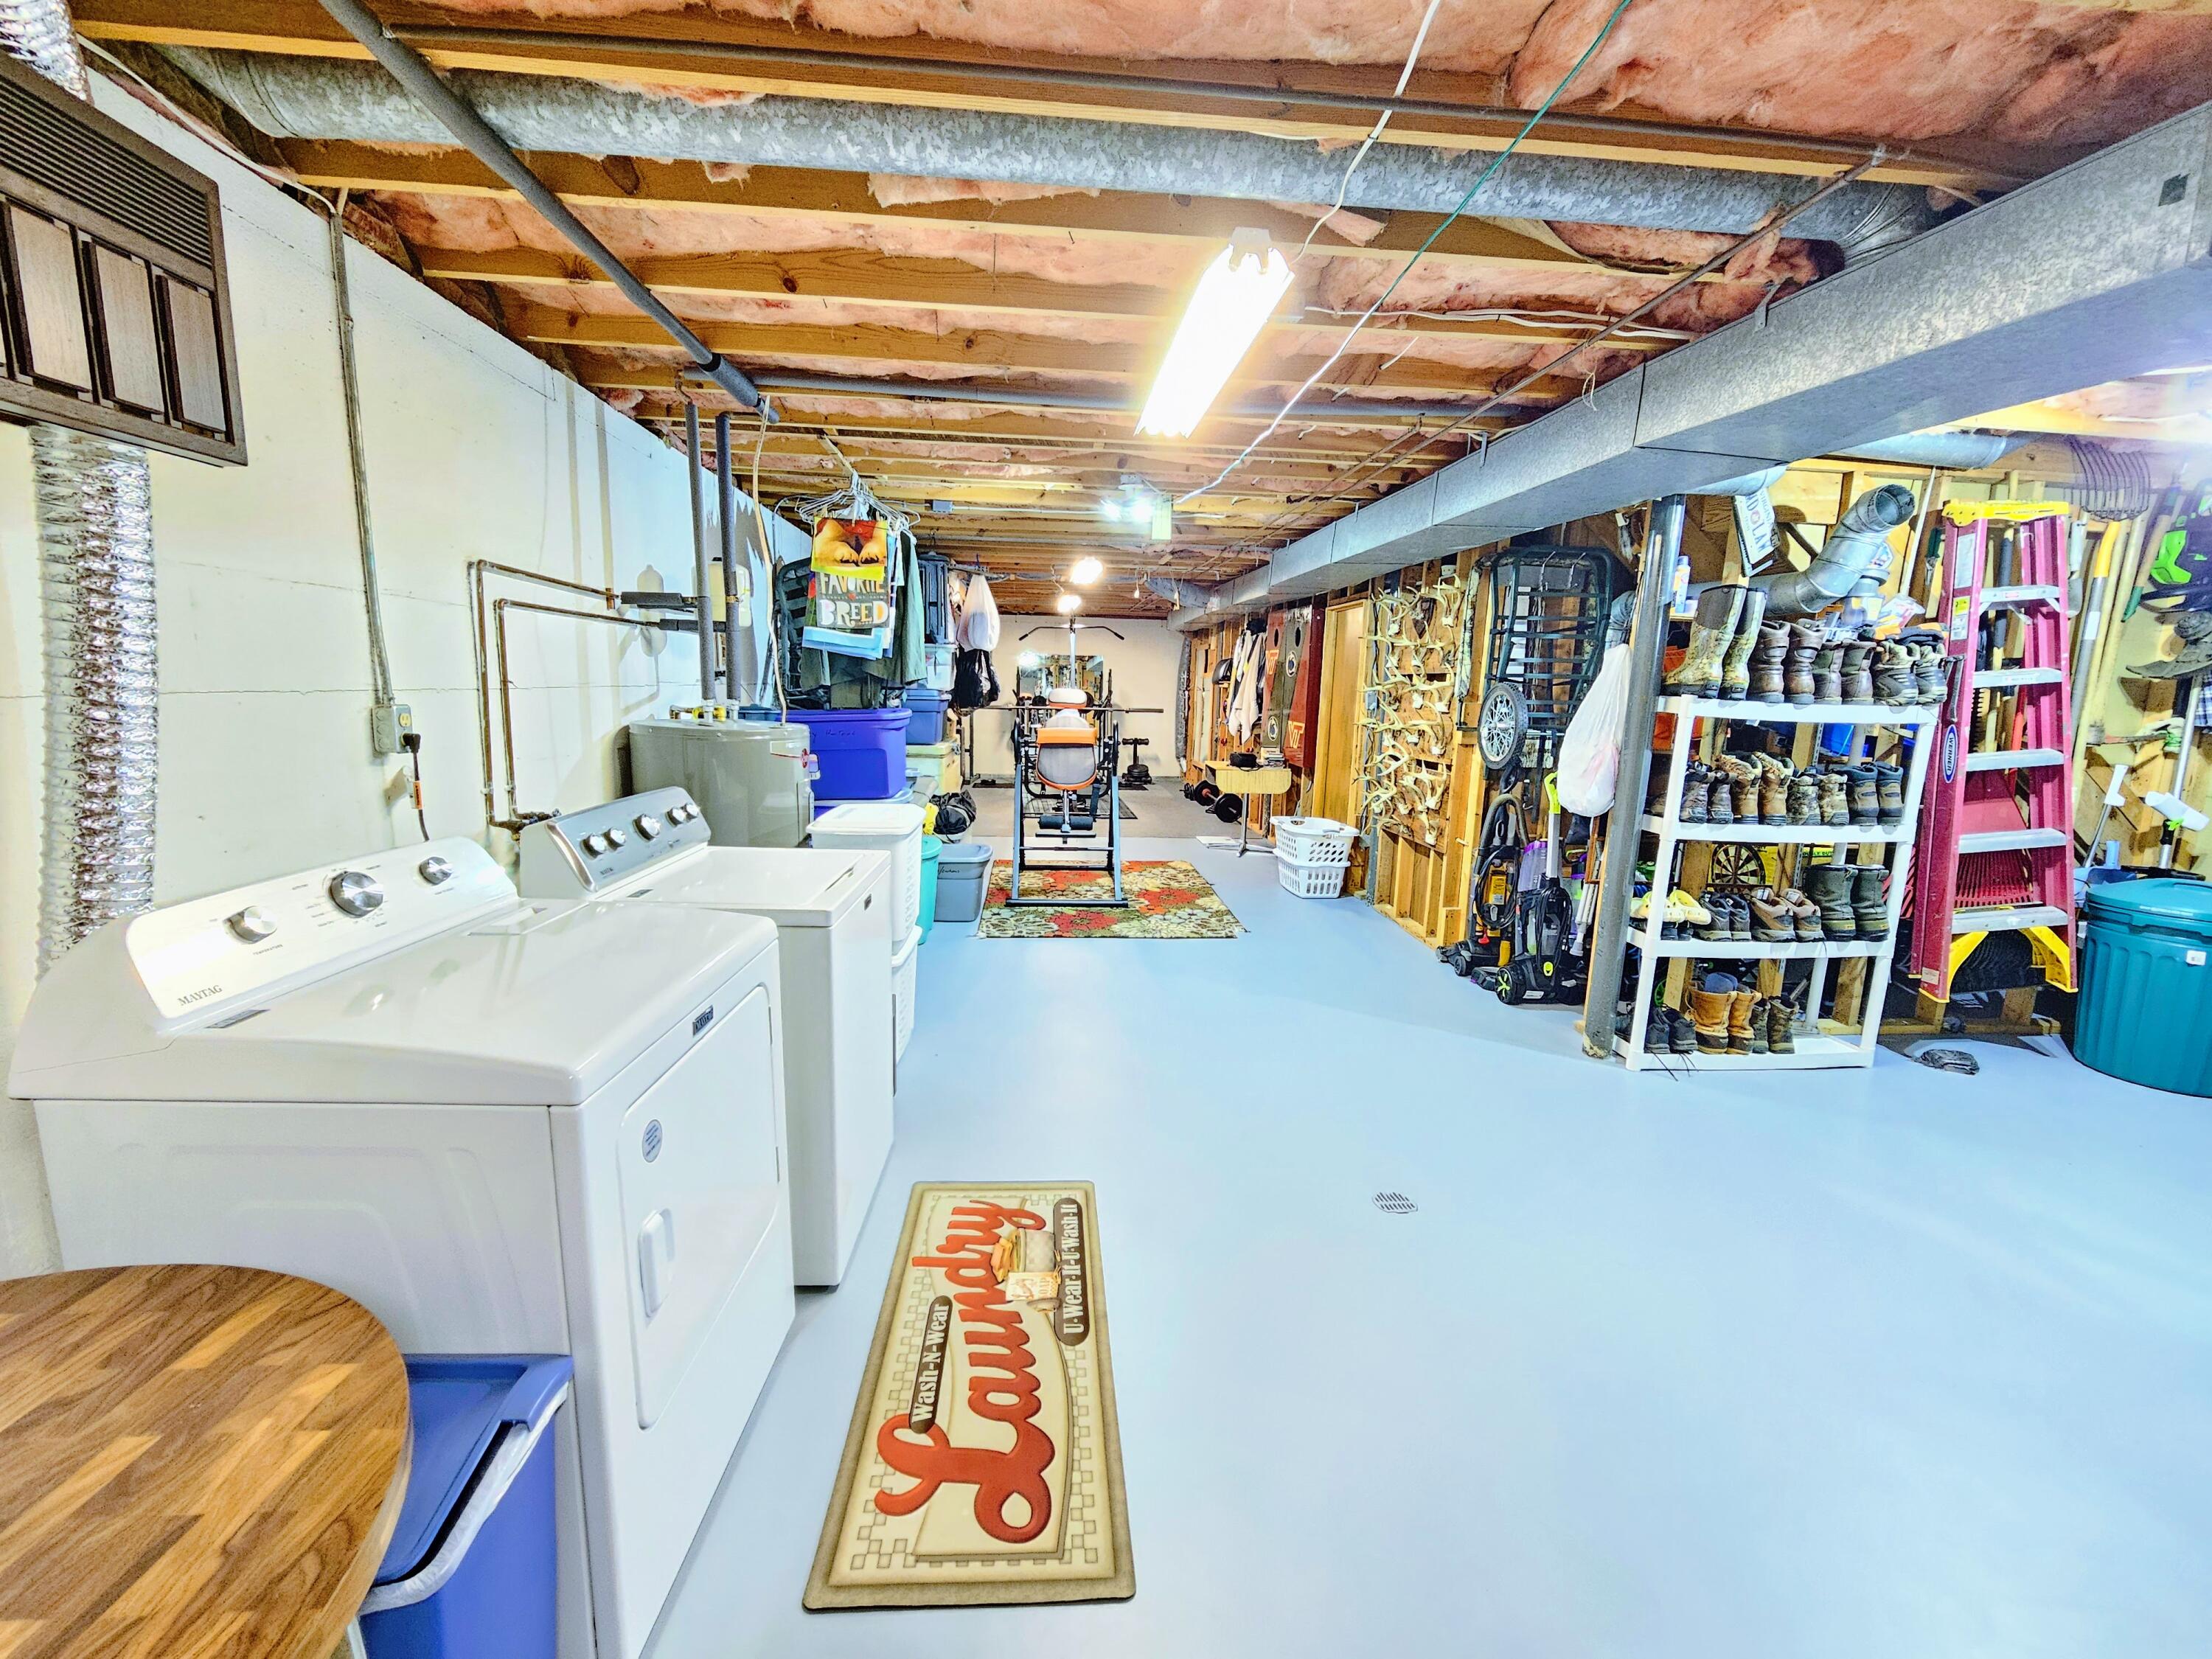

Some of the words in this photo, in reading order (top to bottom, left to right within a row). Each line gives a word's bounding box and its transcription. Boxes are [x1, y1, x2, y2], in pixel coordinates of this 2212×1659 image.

[819, 599, 889, 627] BREED
[1947, 737, 1955, 771] WERNER
[178, 984, 223, 1007] MAYTAG
[874, 1200, 1057, 1544] Laundry
[911, 1303, 950, 1424] Wash-N-Wear
